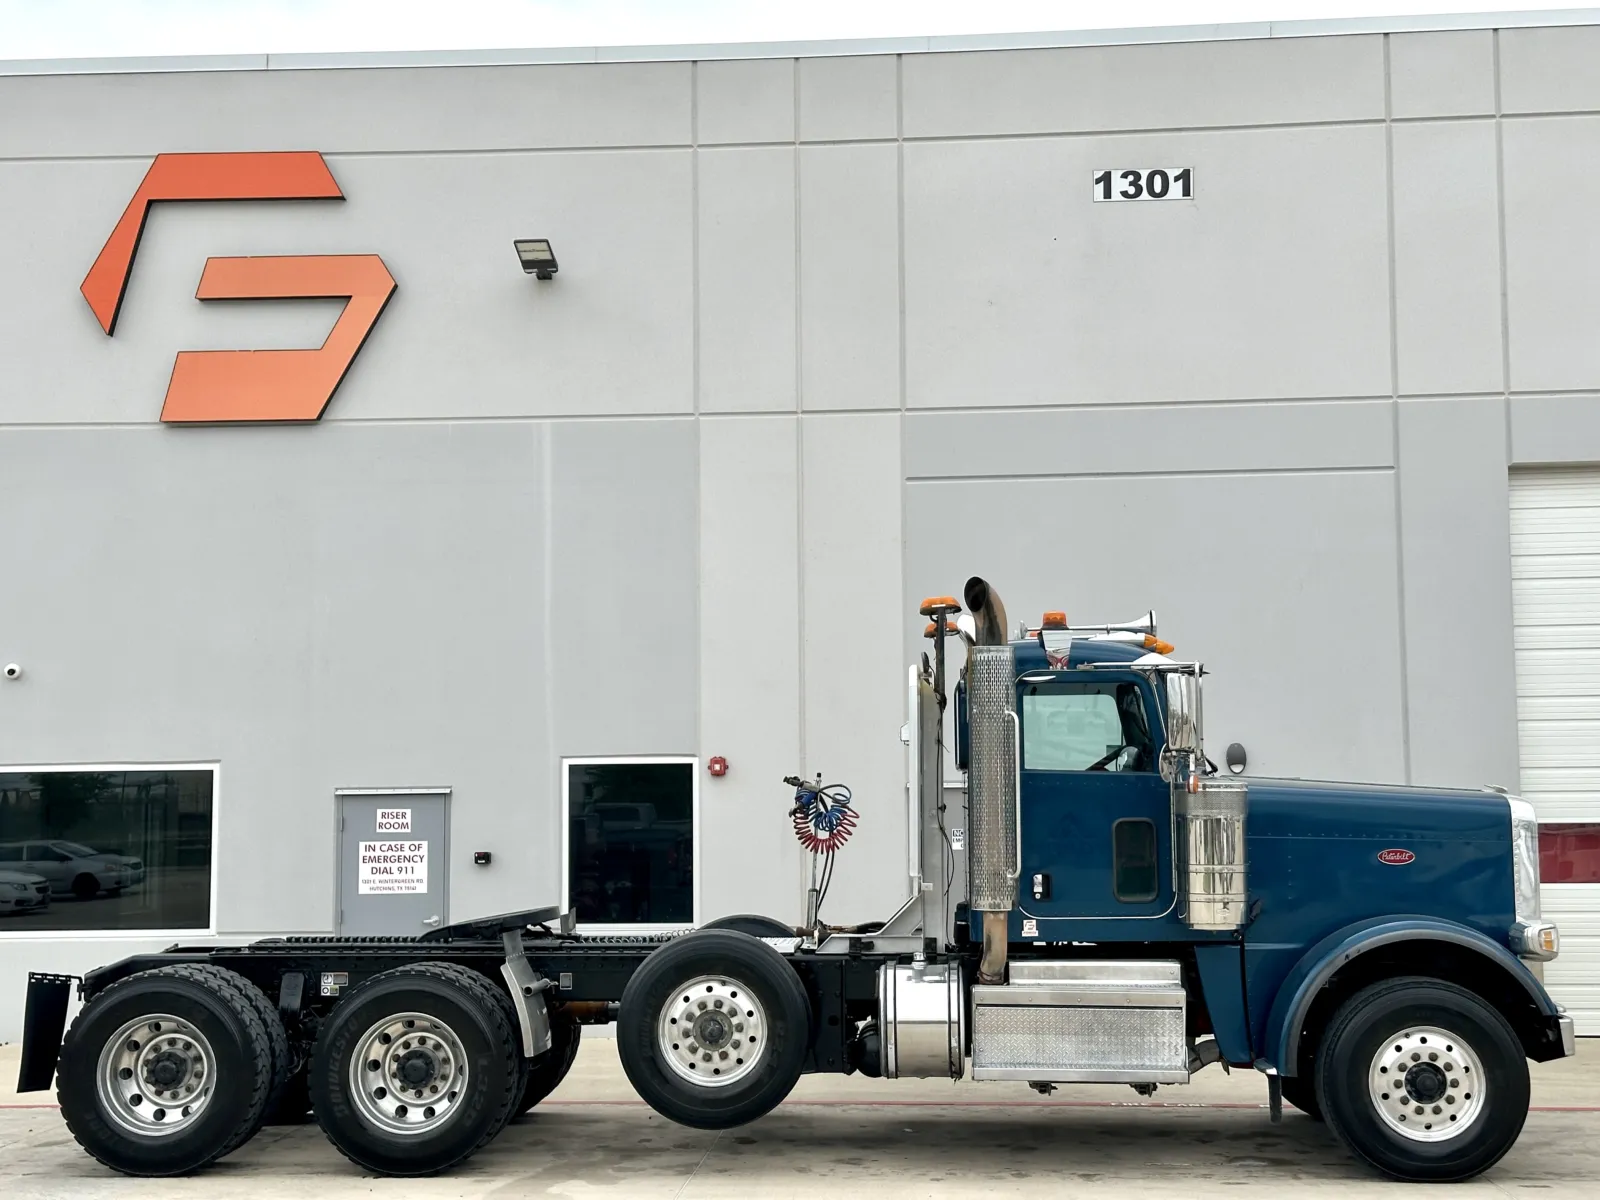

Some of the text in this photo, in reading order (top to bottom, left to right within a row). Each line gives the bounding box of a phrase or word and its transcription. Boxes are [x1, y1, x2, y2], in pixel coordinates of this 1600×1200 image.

[1094, 168, 1191, 199] 1301
[381, 811, 407, 820] RISER
[378, 822, 410, 830] ROOM
[364, 843, 423, 852] IN CASE OF
[362, 855, 425, 864] EMERGENCY
[1382, 851, 1411, 860] Peterbilt
[371, 866, 415, 875] DIAL 911
